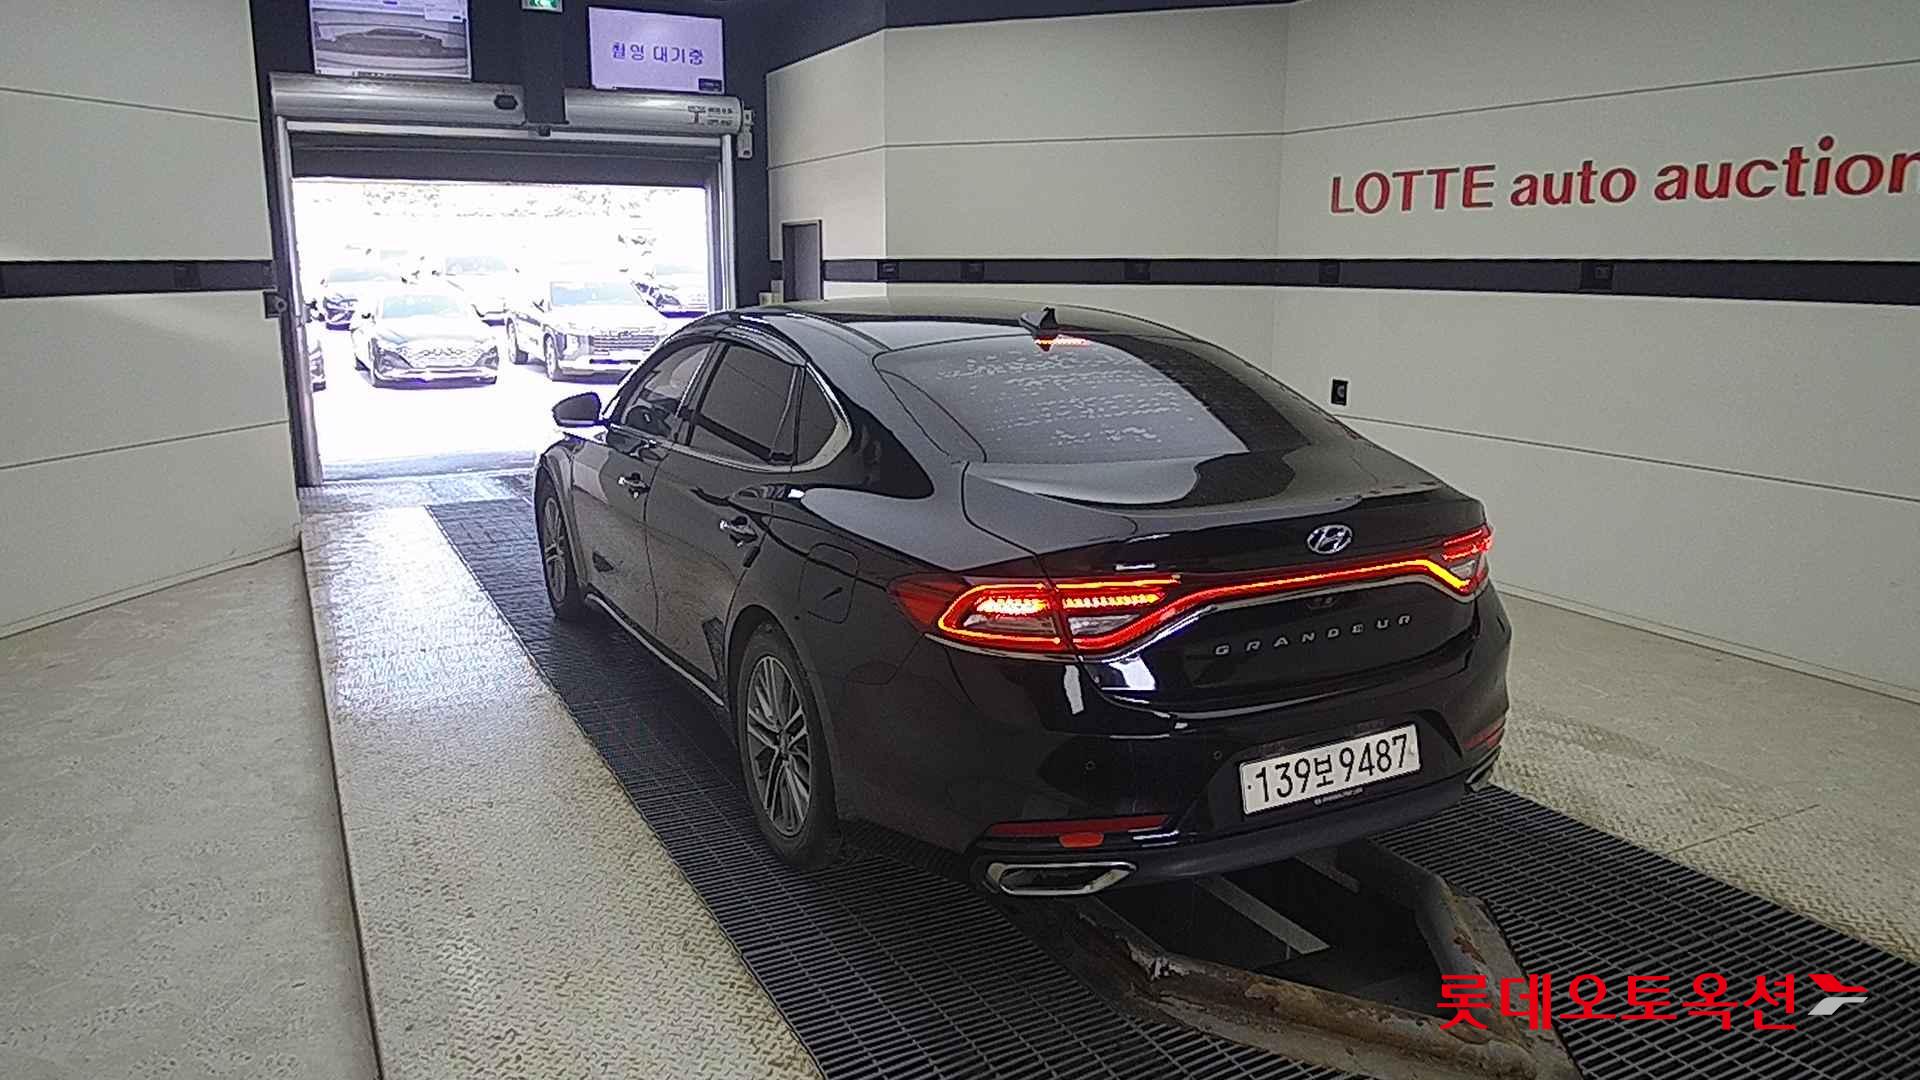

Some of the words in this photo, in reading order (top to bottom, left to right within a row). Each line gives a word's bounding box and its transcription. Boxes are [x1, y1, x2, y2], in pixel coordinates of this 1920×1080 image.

[653, 46, 703, 65] 대기중
[1331, 165, 1496, 214] LOTTE
[1511, 160, 1637, 207] auto
[1215, 615, 1411, 655] GRANDEUR
